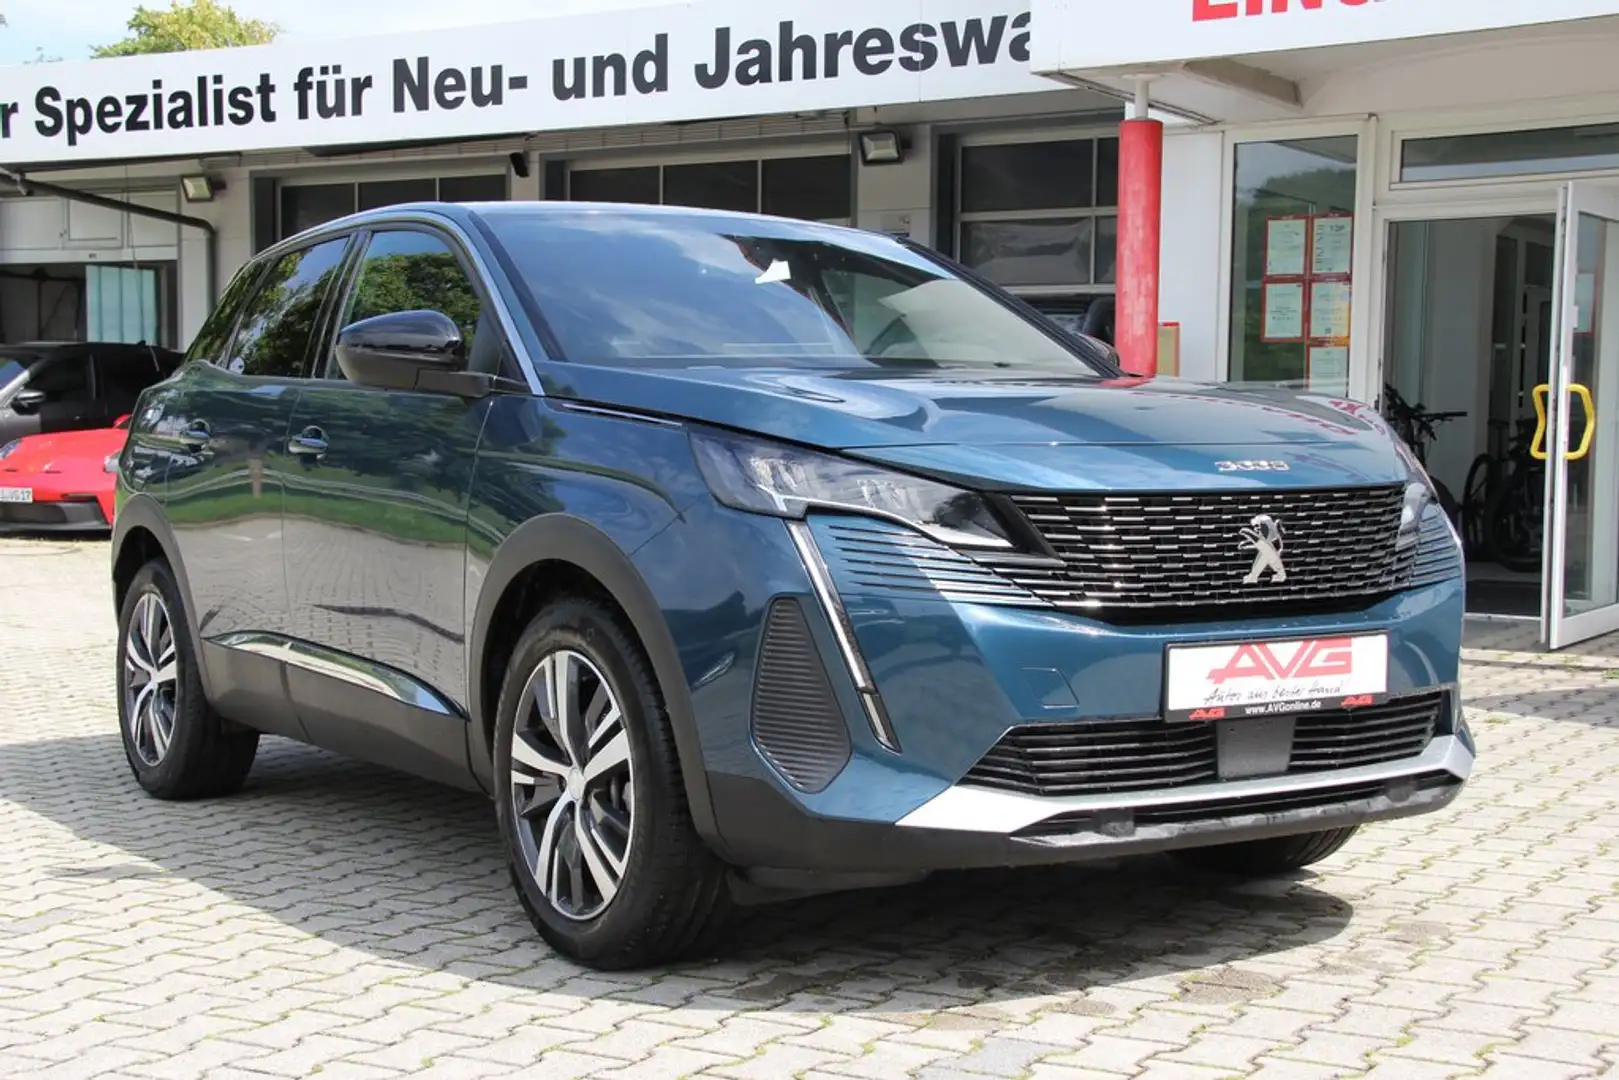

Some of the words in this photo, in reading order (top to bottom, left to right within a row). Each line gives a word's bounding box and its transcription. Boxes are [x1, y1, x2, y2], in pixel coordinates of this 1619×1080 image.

[35, 73, 276, 146] Spezialist
[294, 64, 373, 120] für
[394, 56, 528, 112] Neu-
[552, 33, 668, 101] und
[1206, 637, 1353, 684] AVG
[1244, 699, 1322, 715] www.AVGonline.de
[1341, 694, 1374, 708] AVG
[1189, 706, 1226, 720] AVG
